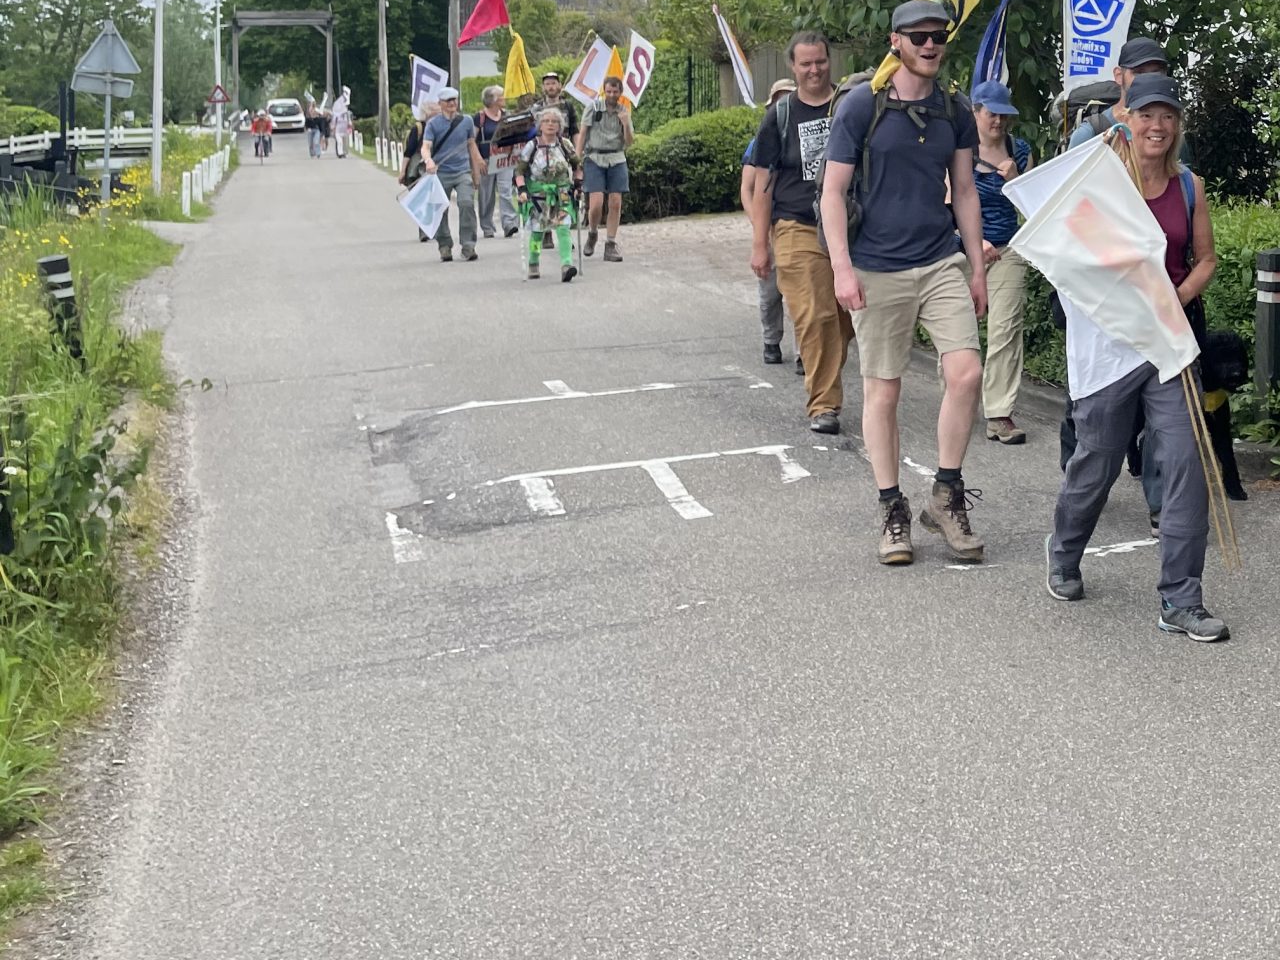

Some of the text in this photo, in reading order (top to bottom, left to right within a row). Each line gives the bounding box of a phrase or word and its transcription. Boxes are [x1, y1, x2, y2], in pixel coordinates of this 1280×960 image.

[412, 63, 441, 107] F
[574, 47, 599, 99] L
[626, 46, 651, 97] S
